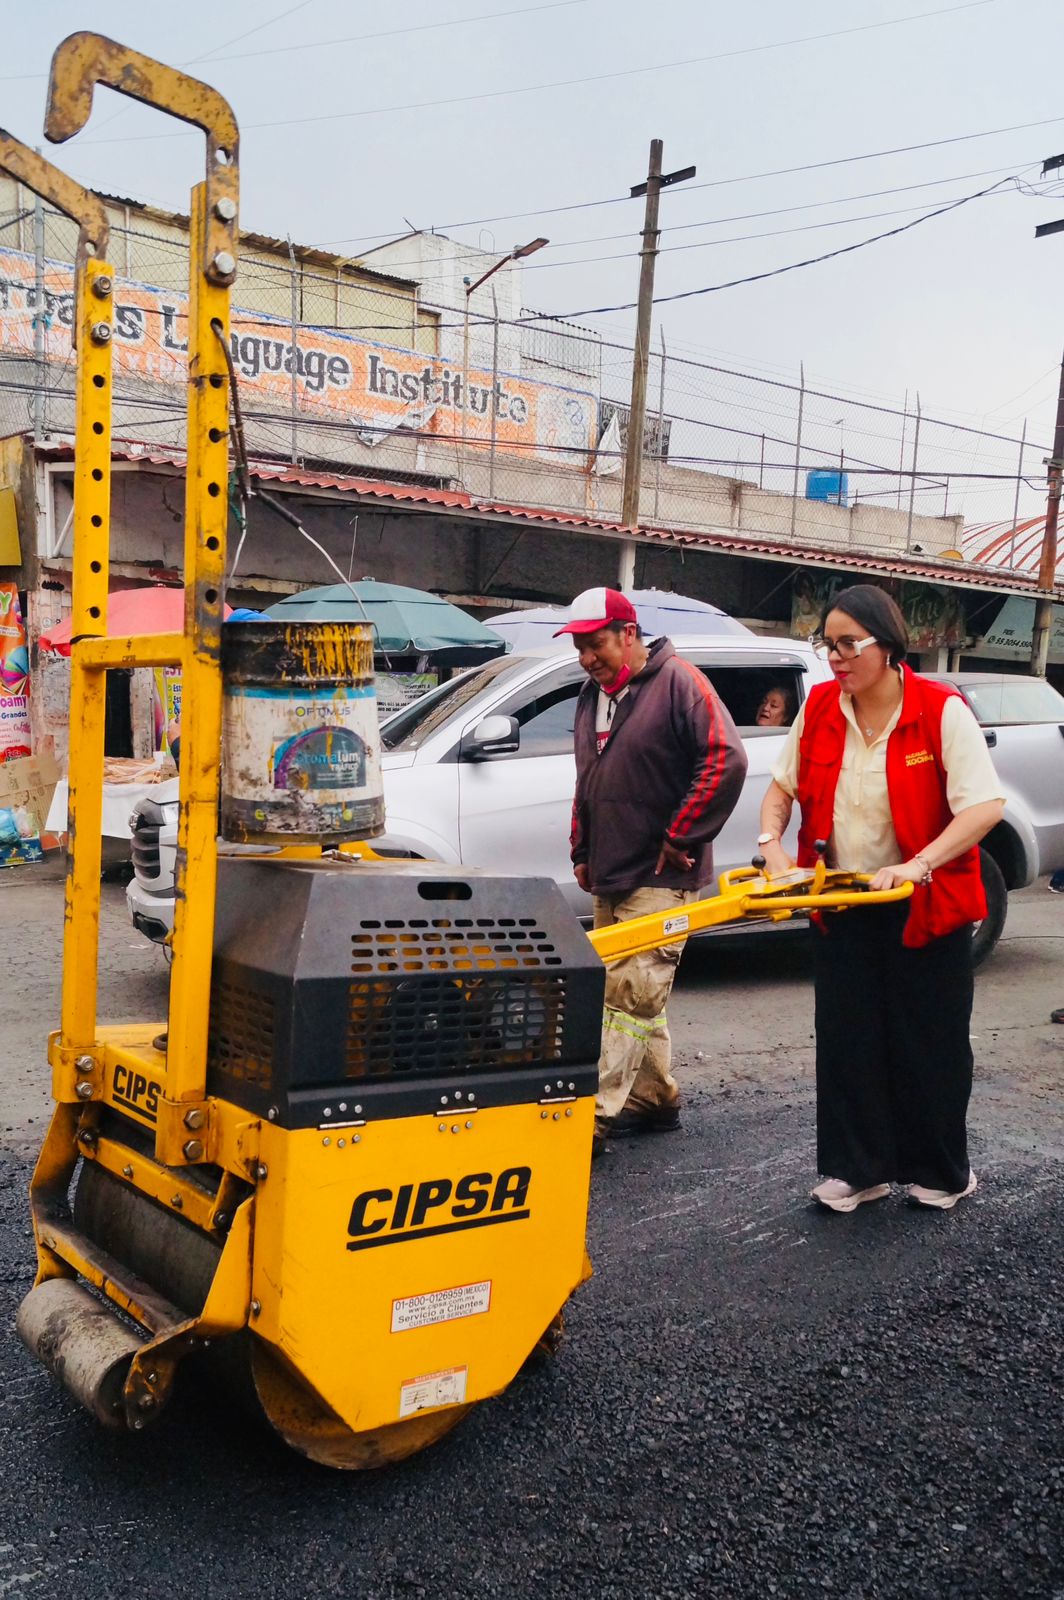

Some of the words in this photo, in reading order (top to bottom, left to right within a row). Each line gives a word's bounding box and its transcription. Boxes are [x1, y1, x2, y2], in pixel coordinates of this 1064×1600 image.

[162, 304, 351, 392] Lguage
[0, 695, 27, 709] oamy
[112, 1064, 166, 1114] CIPS
[347, 1166, 532, 1237] CIPSA
[395, 1287, 464, 1311] 01-800-0126959
[397, 1310, 437, 1325] Servicio
[439, 1307, 446, 1316] a
[447, 1298, 484, 1314] Clientes
[408, 1295, 476, 1314] www.cipsa.com.mx
[408, 1314, 446, 1328] CUSTOMER
